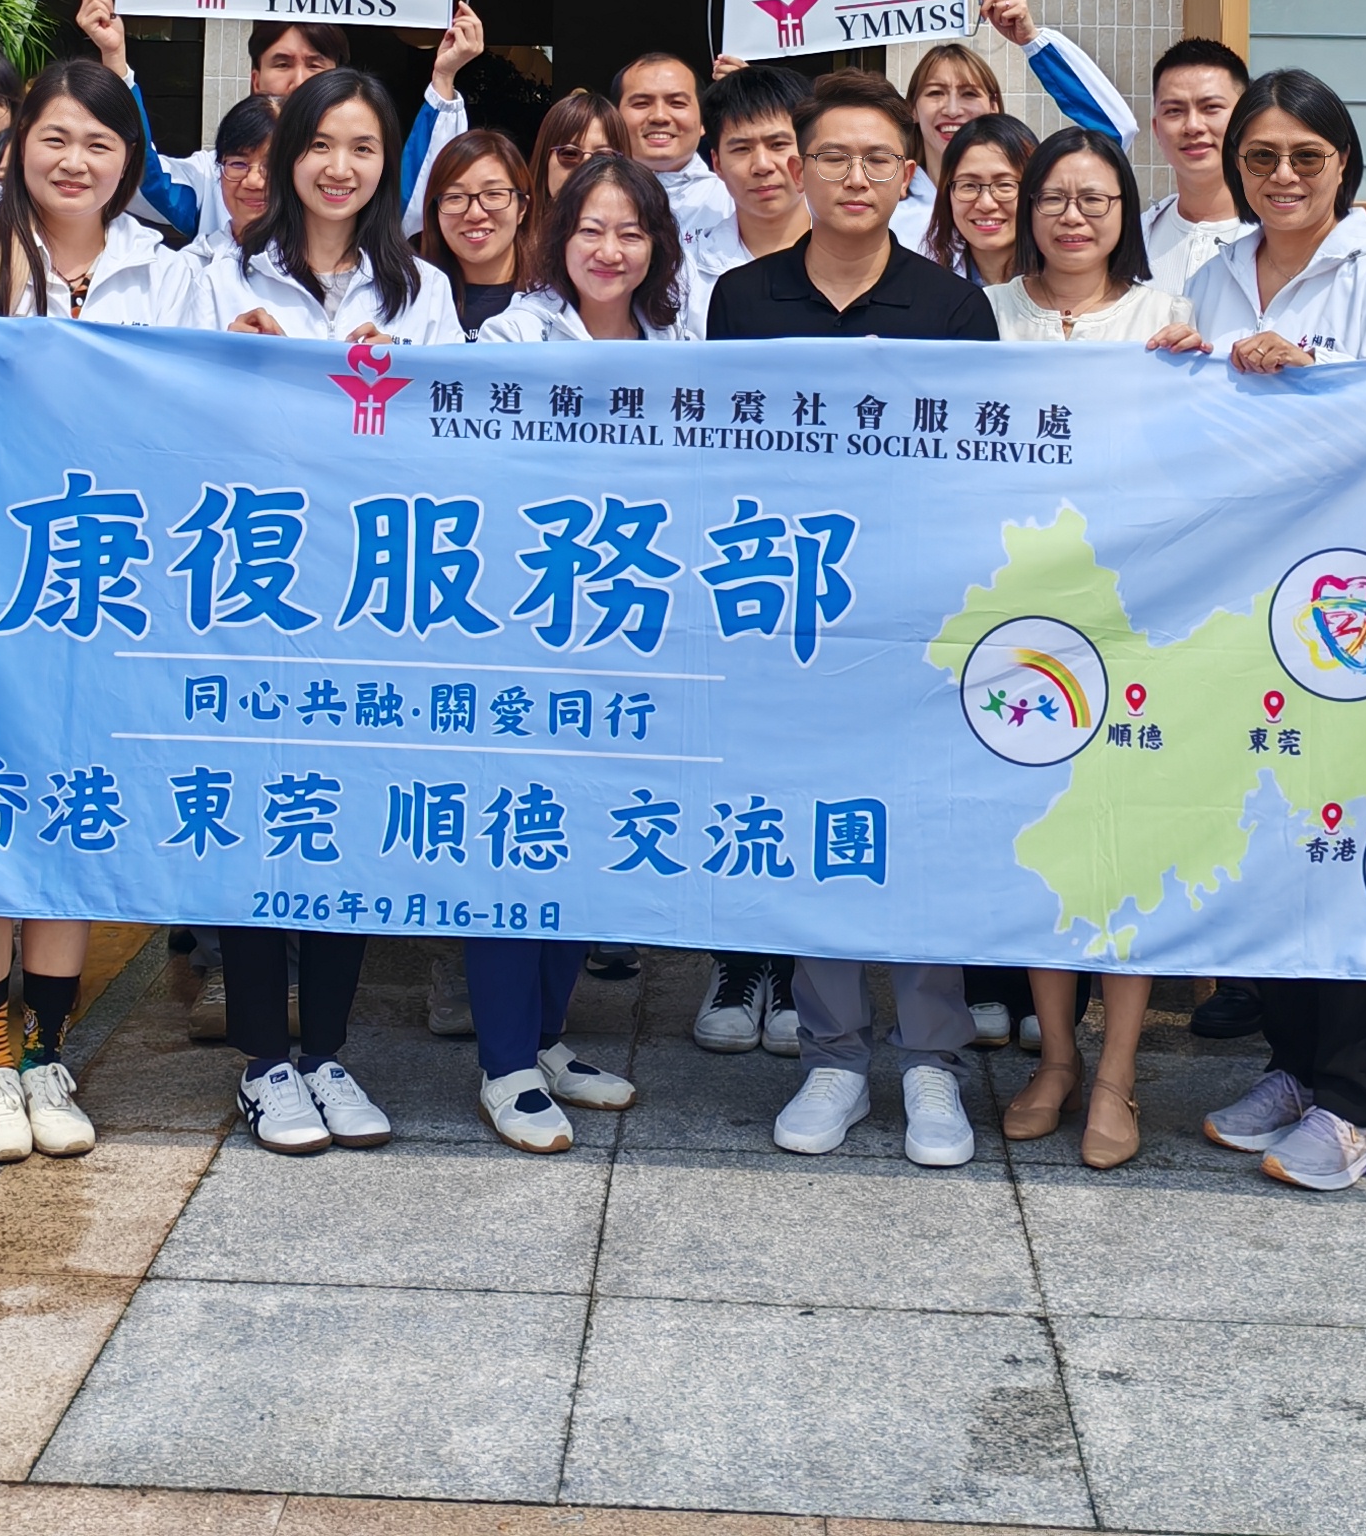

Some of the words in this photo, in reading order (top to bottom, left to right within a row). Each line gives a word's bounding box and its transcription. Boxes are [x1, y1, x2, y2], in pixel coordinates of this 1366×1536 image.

[835, 2, 964, 42] YMMSS
[430, 380, 1072, 440] 循道衛理楊震社會服務處
[430, 417, 501, 440] YANG
[511, 420, 663, 447] MEMORIAL
[673, 426, 838, 454] METHODIST
[847, 433, 948, 459] SOCIAL
[956, 439, 1073, 465] SERVICE
[1106, 722, 1163, 751] 順德
[1247, 727, 1302, 756] 東莞
[156, 765, 342, 864] 東莞
[379, 780, 573, 874] 順德
[600, 788, 890, 886] 交流團
[1306, 837, 1357, 864] 香港
